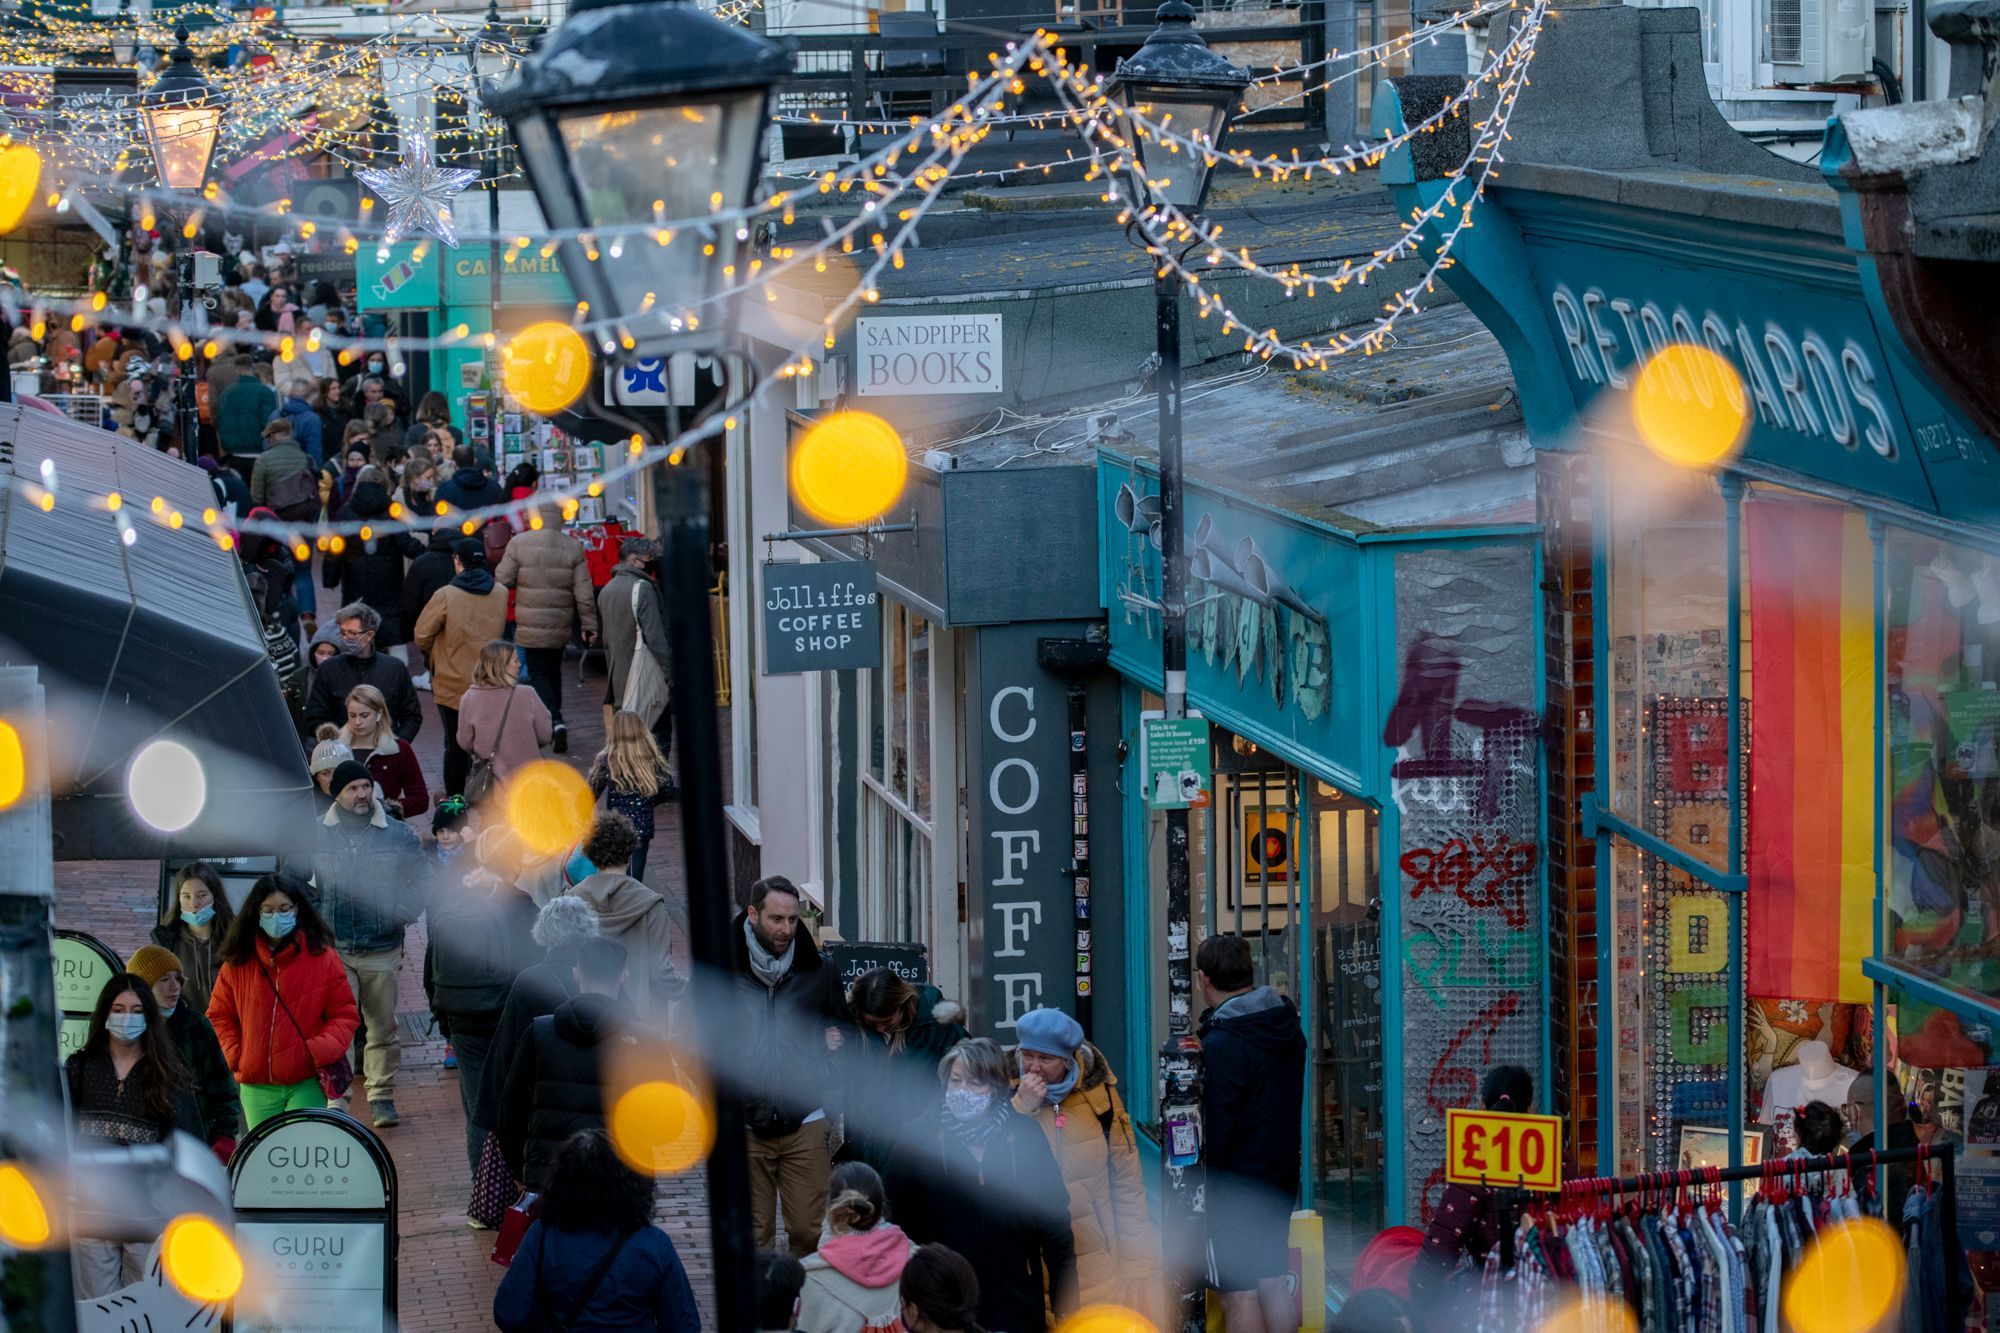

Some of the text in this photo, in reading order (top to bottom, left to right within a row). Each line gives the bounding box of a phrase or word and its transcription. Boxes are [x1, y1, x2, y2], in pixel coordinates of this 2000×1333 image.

[300, 259, 355, 273] residen
[456, 257, 561, 277] CAAMEL
[867, 324, 991, 346] SANDPIPER
[868, 351, 992, 386] BOOKS
[1552, 284, 1897, 461] RETROCARDS
[1917, 423, 1951, 452] 01273
[767, 582, 876, 610] Jolliffes
[778, 613, 862, 632] COFFEE
[795, 635, 851, 652] SHOP
[1188, 737, 1207, 745] £150
[989, 686, 1044, 1050] COFFE
[54, 959, 93, 979] RU
[267, 1146, 350, 1169] GURU
[1462, 1124, 1545, 1175] £10
[272, 1237, 344, 1256] GURU
